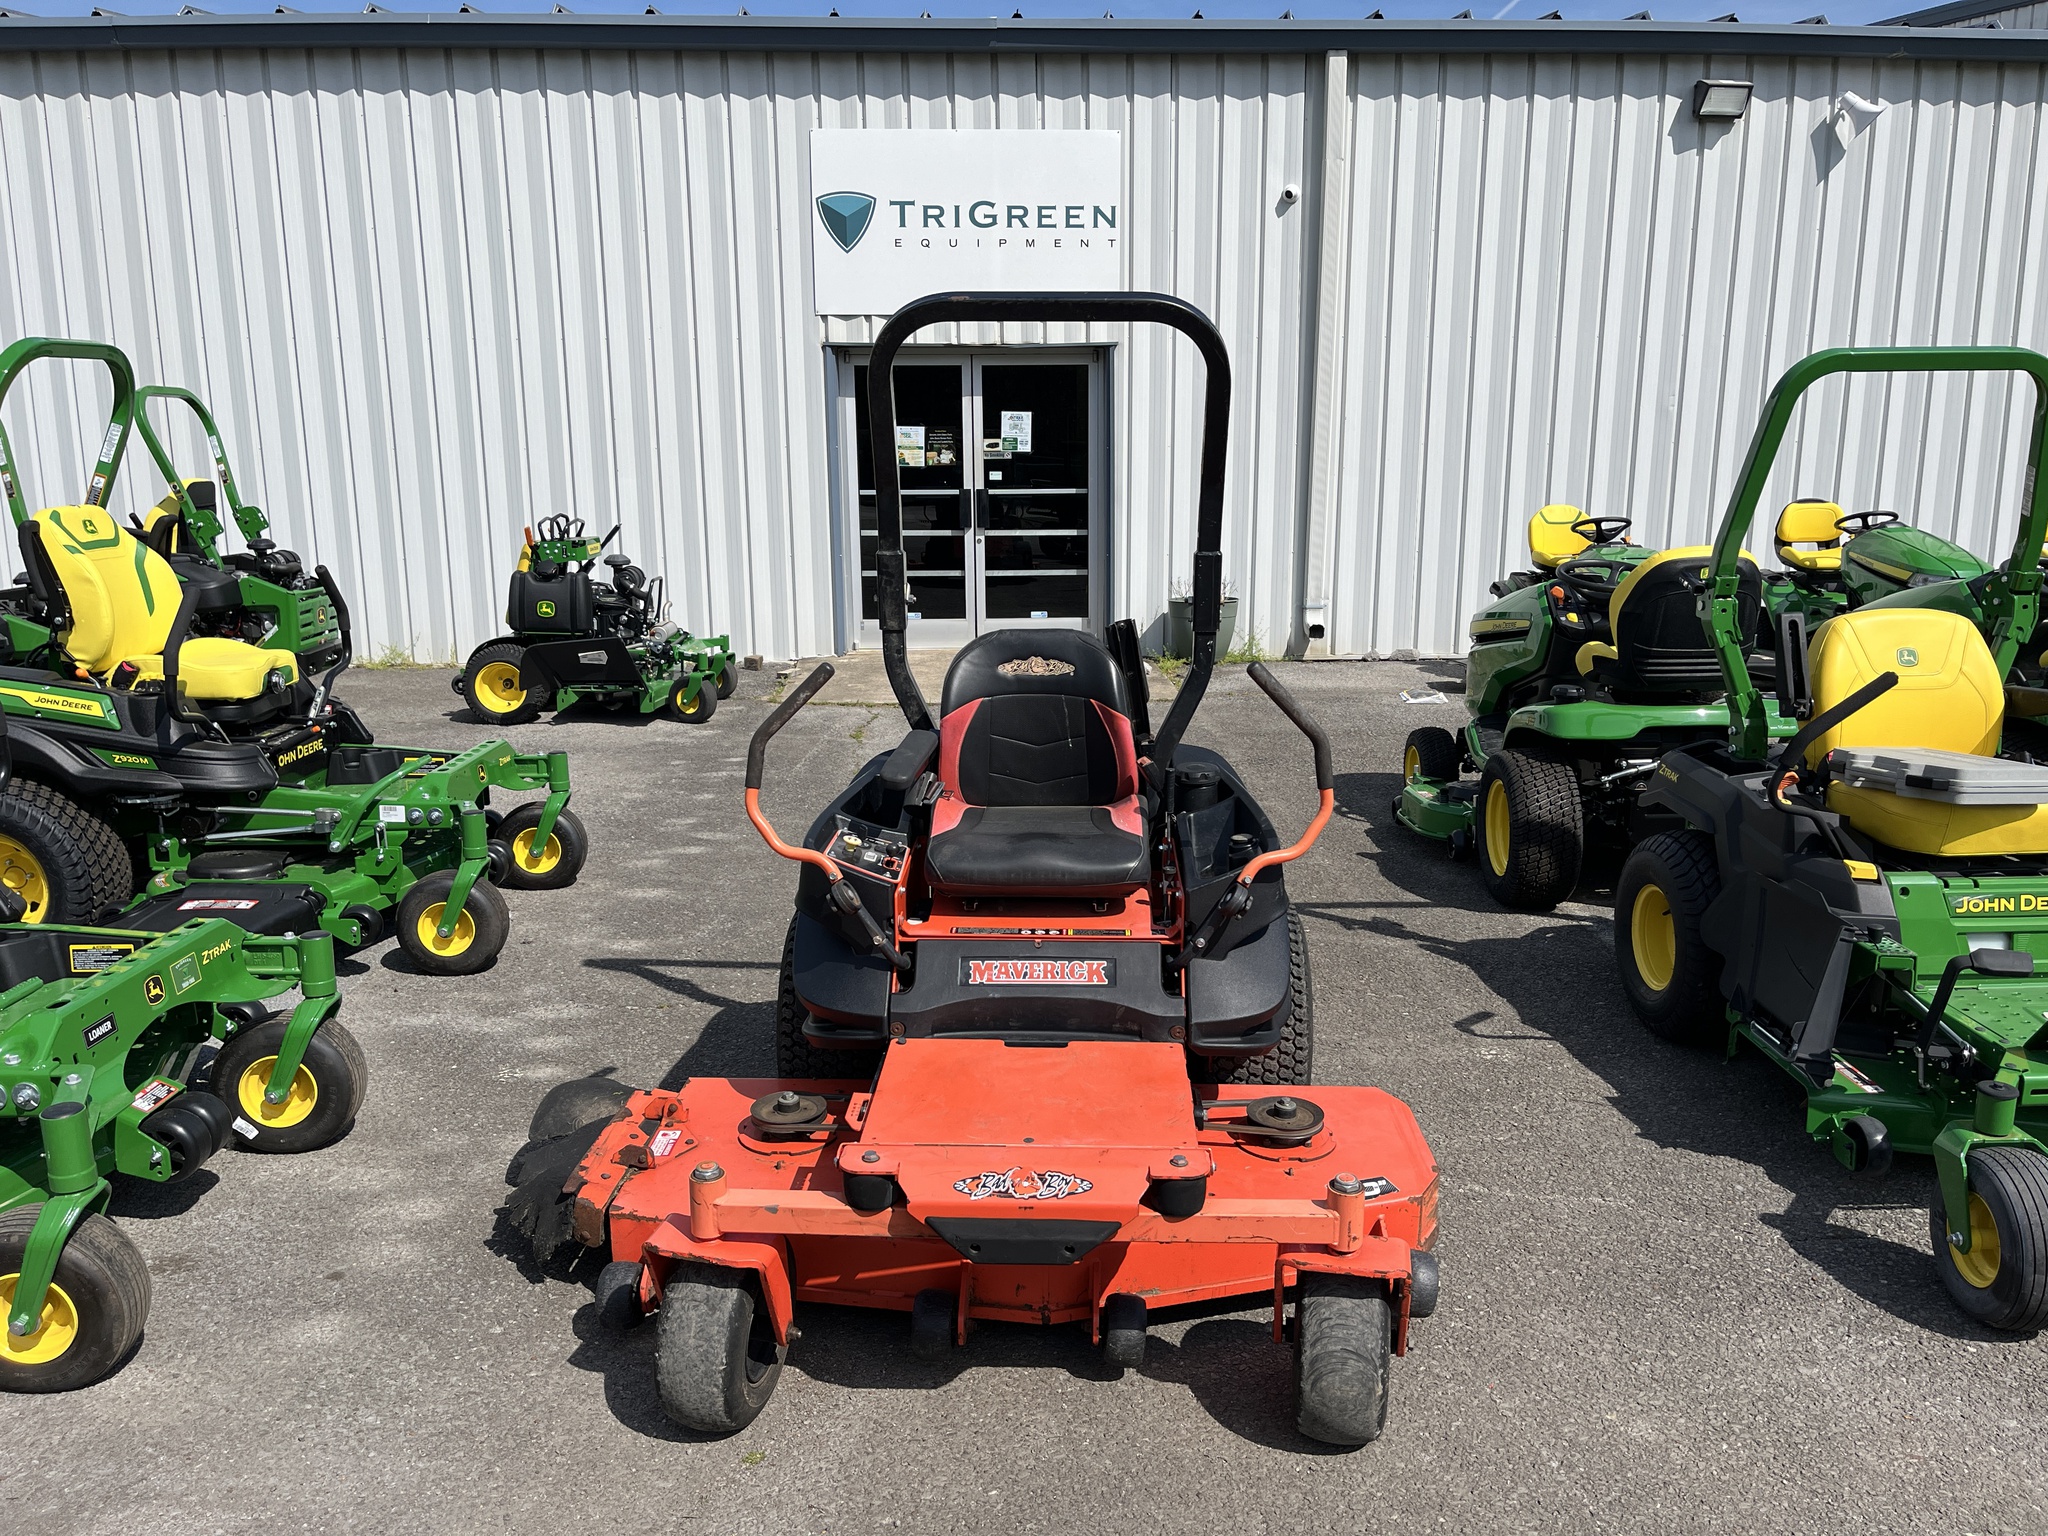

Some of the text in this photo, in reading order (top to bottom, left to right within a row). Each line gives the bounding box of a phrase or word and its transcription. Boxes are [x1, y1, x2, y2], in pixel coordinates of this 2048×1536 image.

[889, 200, 1117, 229] TRIGREEN
[894, 238, 1117, 249] EQUIPMENT
[34, 696, 93, 711] JOHN DEERE
[112, 754, 149, 765] Z920M
[278, 738, 324, 768] OHN DEERE
[1658, 763, 1680, 783] ZTRAK
[1955, 896, 2015, 914] JOHN
[201, 938, 232, 966] ZTRAK
[969, 960, 1109, 985] MAVERICK
[88, 1020, 113, 1042] LOANER
[970, 1168, 1075, 1200] Bad Boy
